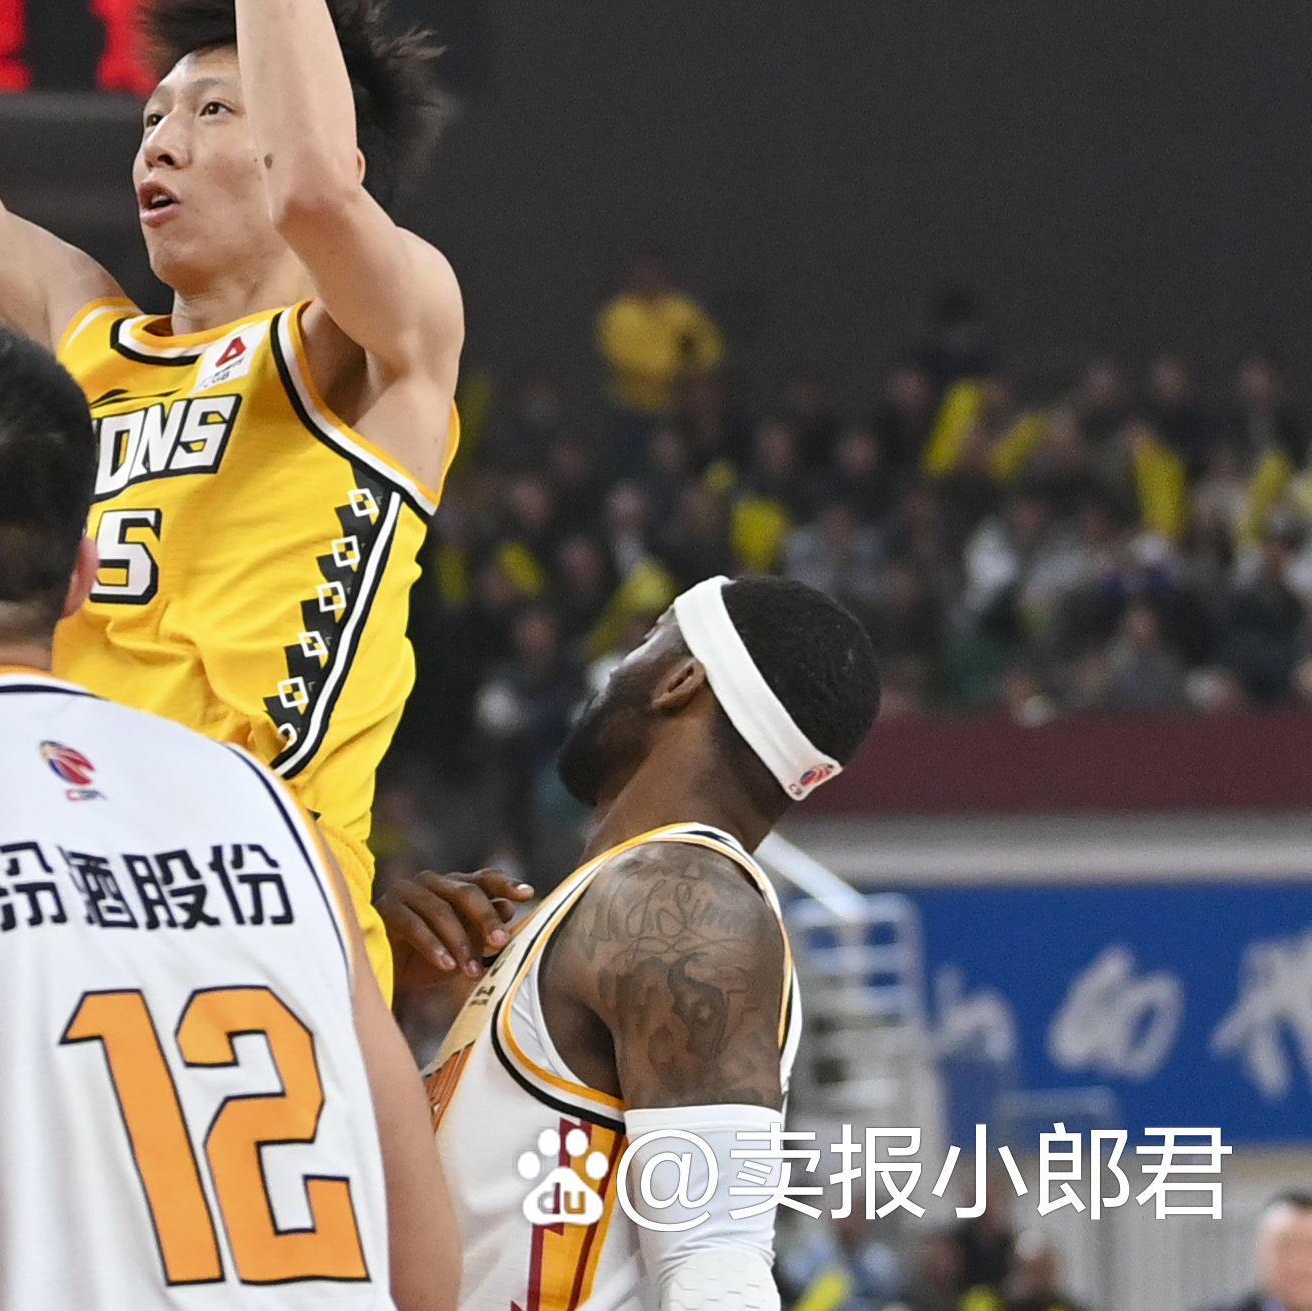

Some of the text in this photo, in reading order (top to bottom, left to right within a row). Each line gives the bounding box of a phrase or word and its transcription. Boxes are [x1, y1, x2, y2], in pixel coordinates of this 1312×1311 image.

[90, 392, 244, 507] ONS
[82, 507, 163, 606] 5
[58, 984, 372, 1287] 12
